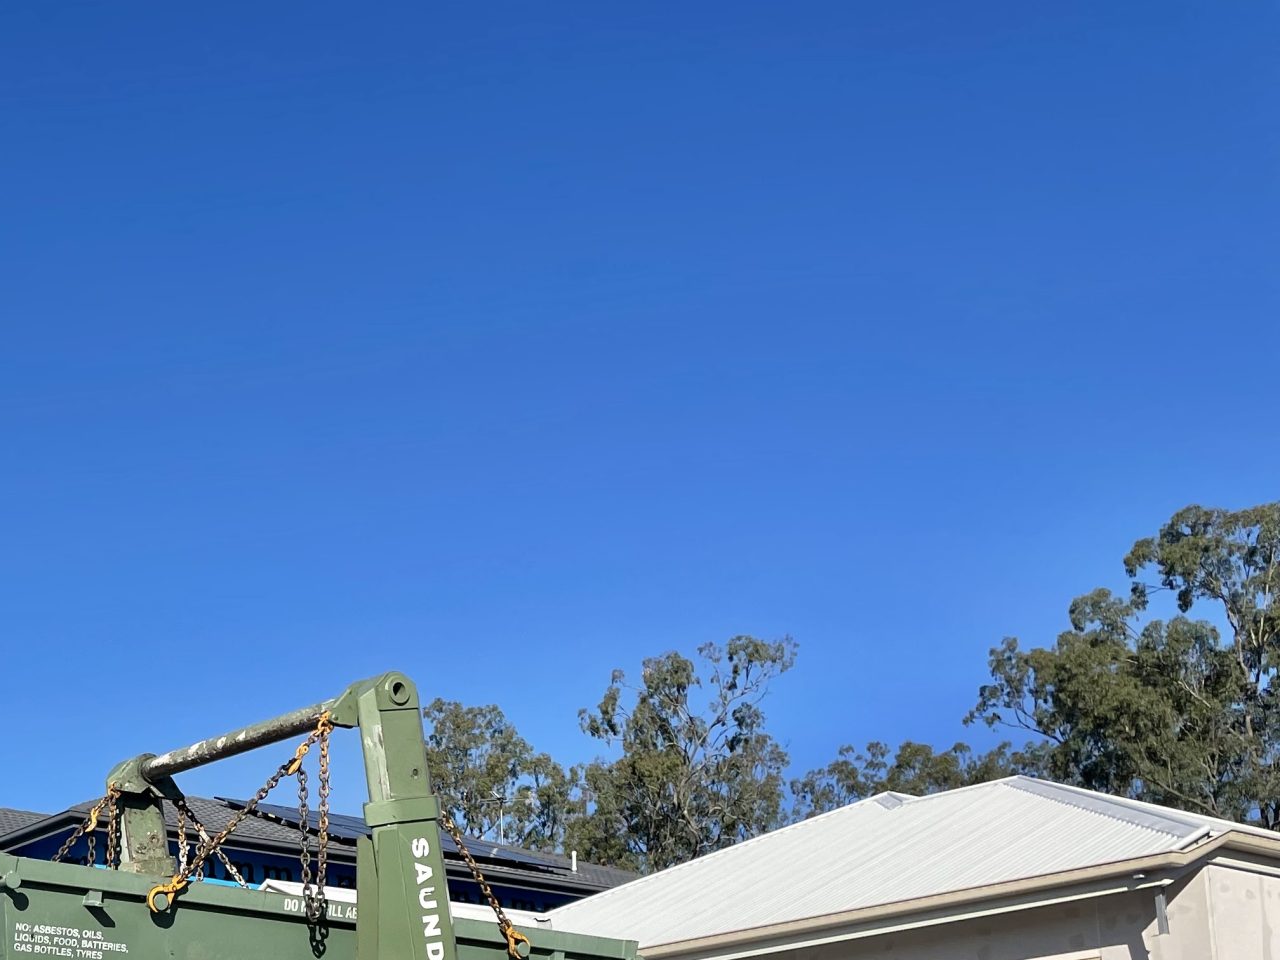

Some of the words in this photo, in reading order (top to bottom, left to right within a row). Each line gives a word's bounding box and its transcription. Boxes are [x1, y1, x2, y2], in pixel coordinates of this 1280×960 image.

[284, 899, 299, 911] DO
[33, 924, 81, 939] ASBESTOS,
[82, 929, 104, 940] OILS,
[14, 933, 51, 946] LIQUIDS,
[53, 937, 80, 949] FOOD,
[81, 939, 129, 954] BATTERIES,
[14, 943, 32, 954] GAS
[33, 944, 75, 958] BOTTLES,
[76, 948, 103, 960] TYRES
